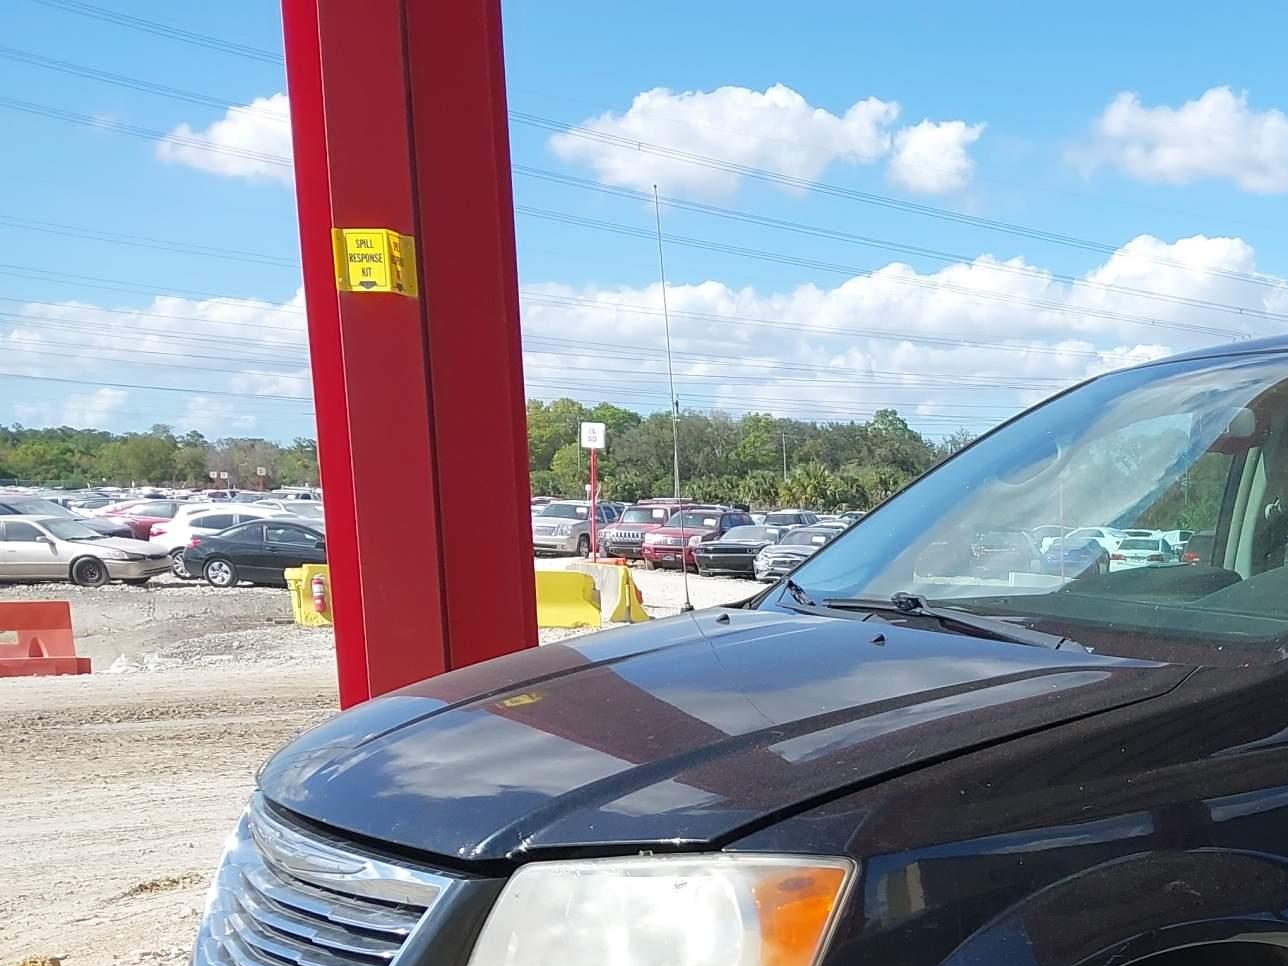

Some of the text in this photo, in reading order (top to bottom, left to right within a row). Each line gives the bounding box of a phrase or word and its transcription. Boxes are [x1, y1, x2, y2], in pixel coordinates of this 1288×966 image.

[355, 239, 375, 249] SPILL
[349, 252, 384, 263] RESPONSE
[361, 267, 373, 277] KIT
